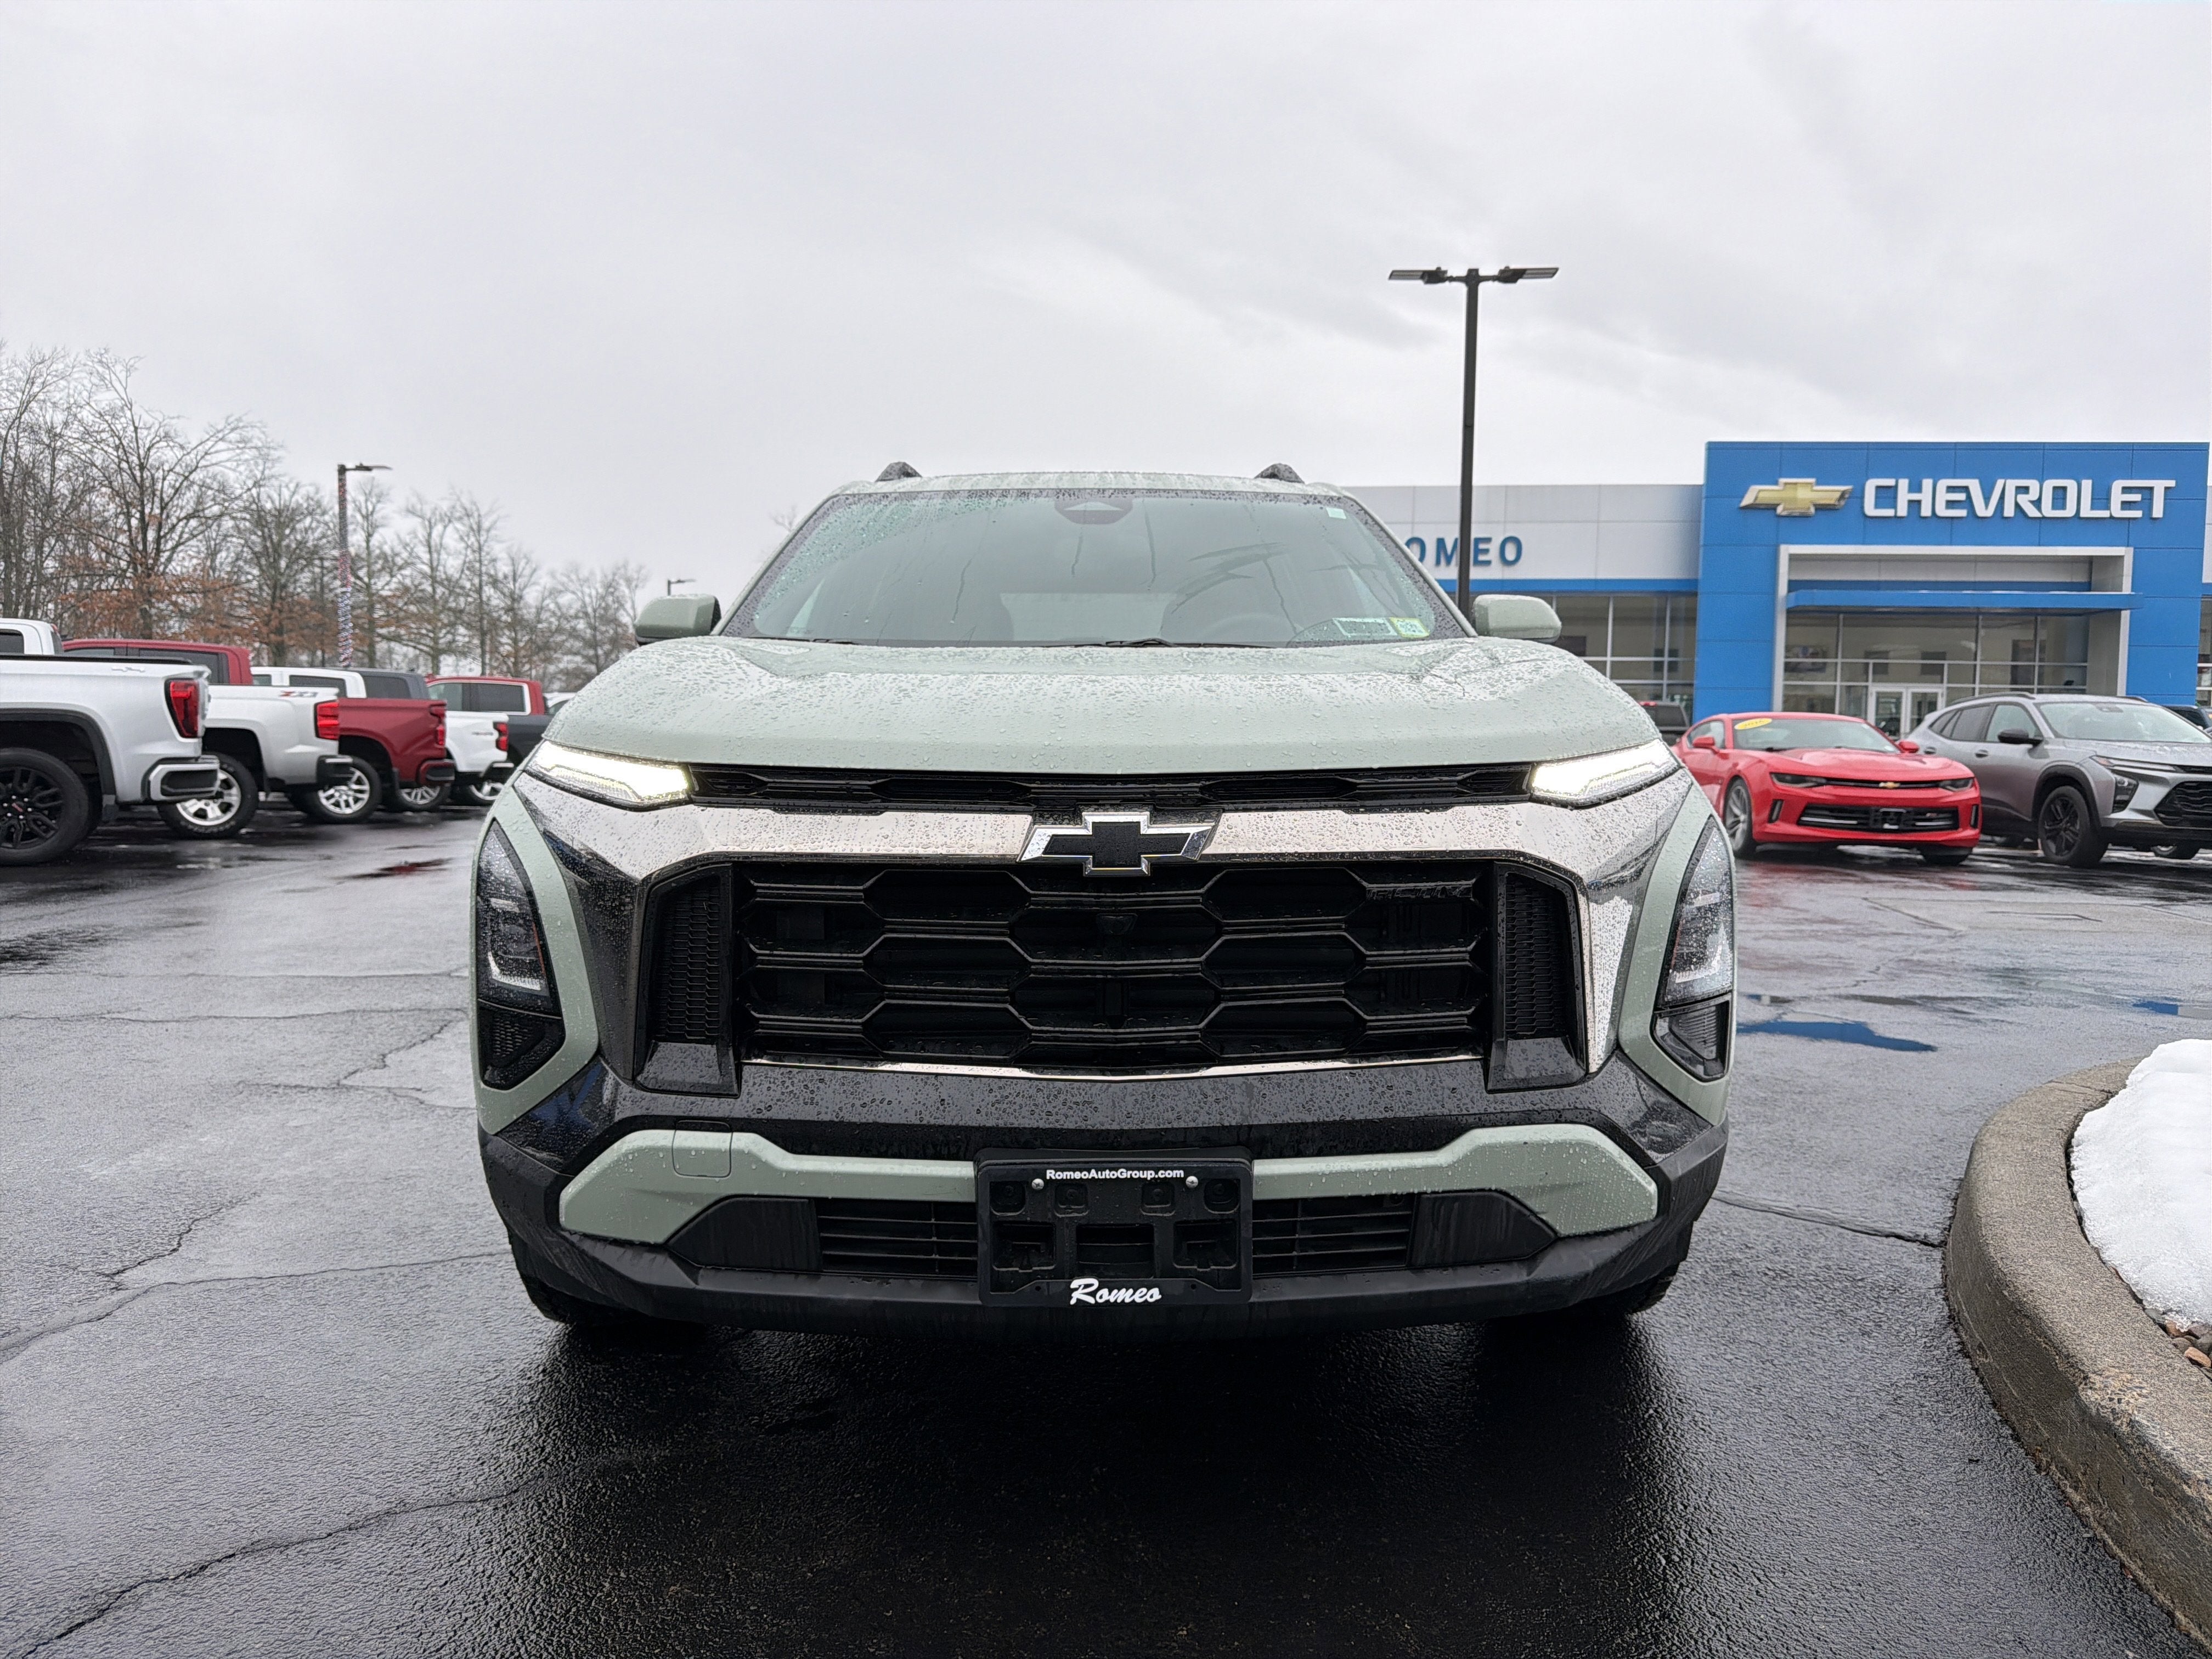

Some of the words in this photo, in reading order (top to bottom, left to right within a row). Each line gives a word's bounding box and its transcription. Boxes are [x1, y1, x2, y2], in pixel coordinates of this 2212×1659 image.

[1864, 478, 2176, 518] CHEVROLET
[1046, 1169, 1184, 1180] RomeoAutoGroup.com
[1070, 1278, 1162, 1305] Romeo
